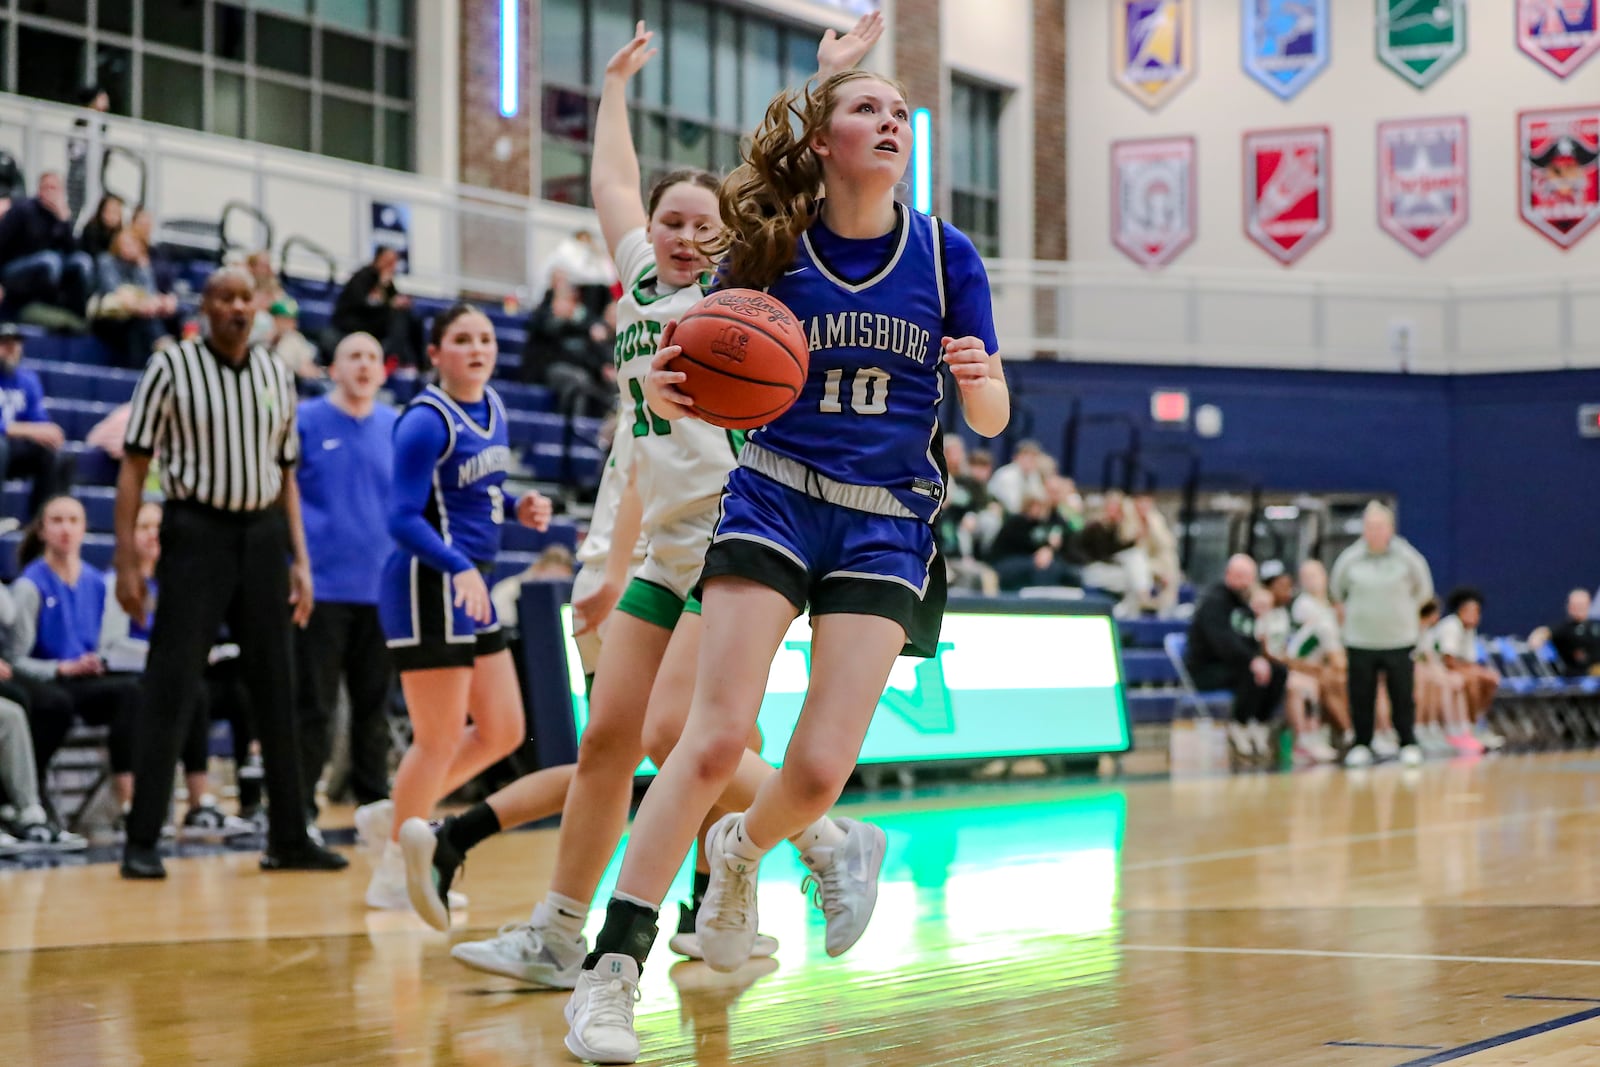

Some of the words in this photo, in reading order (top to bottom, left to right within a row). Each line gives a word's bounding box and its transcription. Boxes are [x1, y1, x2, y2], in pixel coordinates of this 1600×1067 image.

[616, 319, 666, 369] BOLT
[800, 311, 930, 365] AMISBURG
[628, 377, 672, 438] 1
[819, 366, 891, 415] 10
